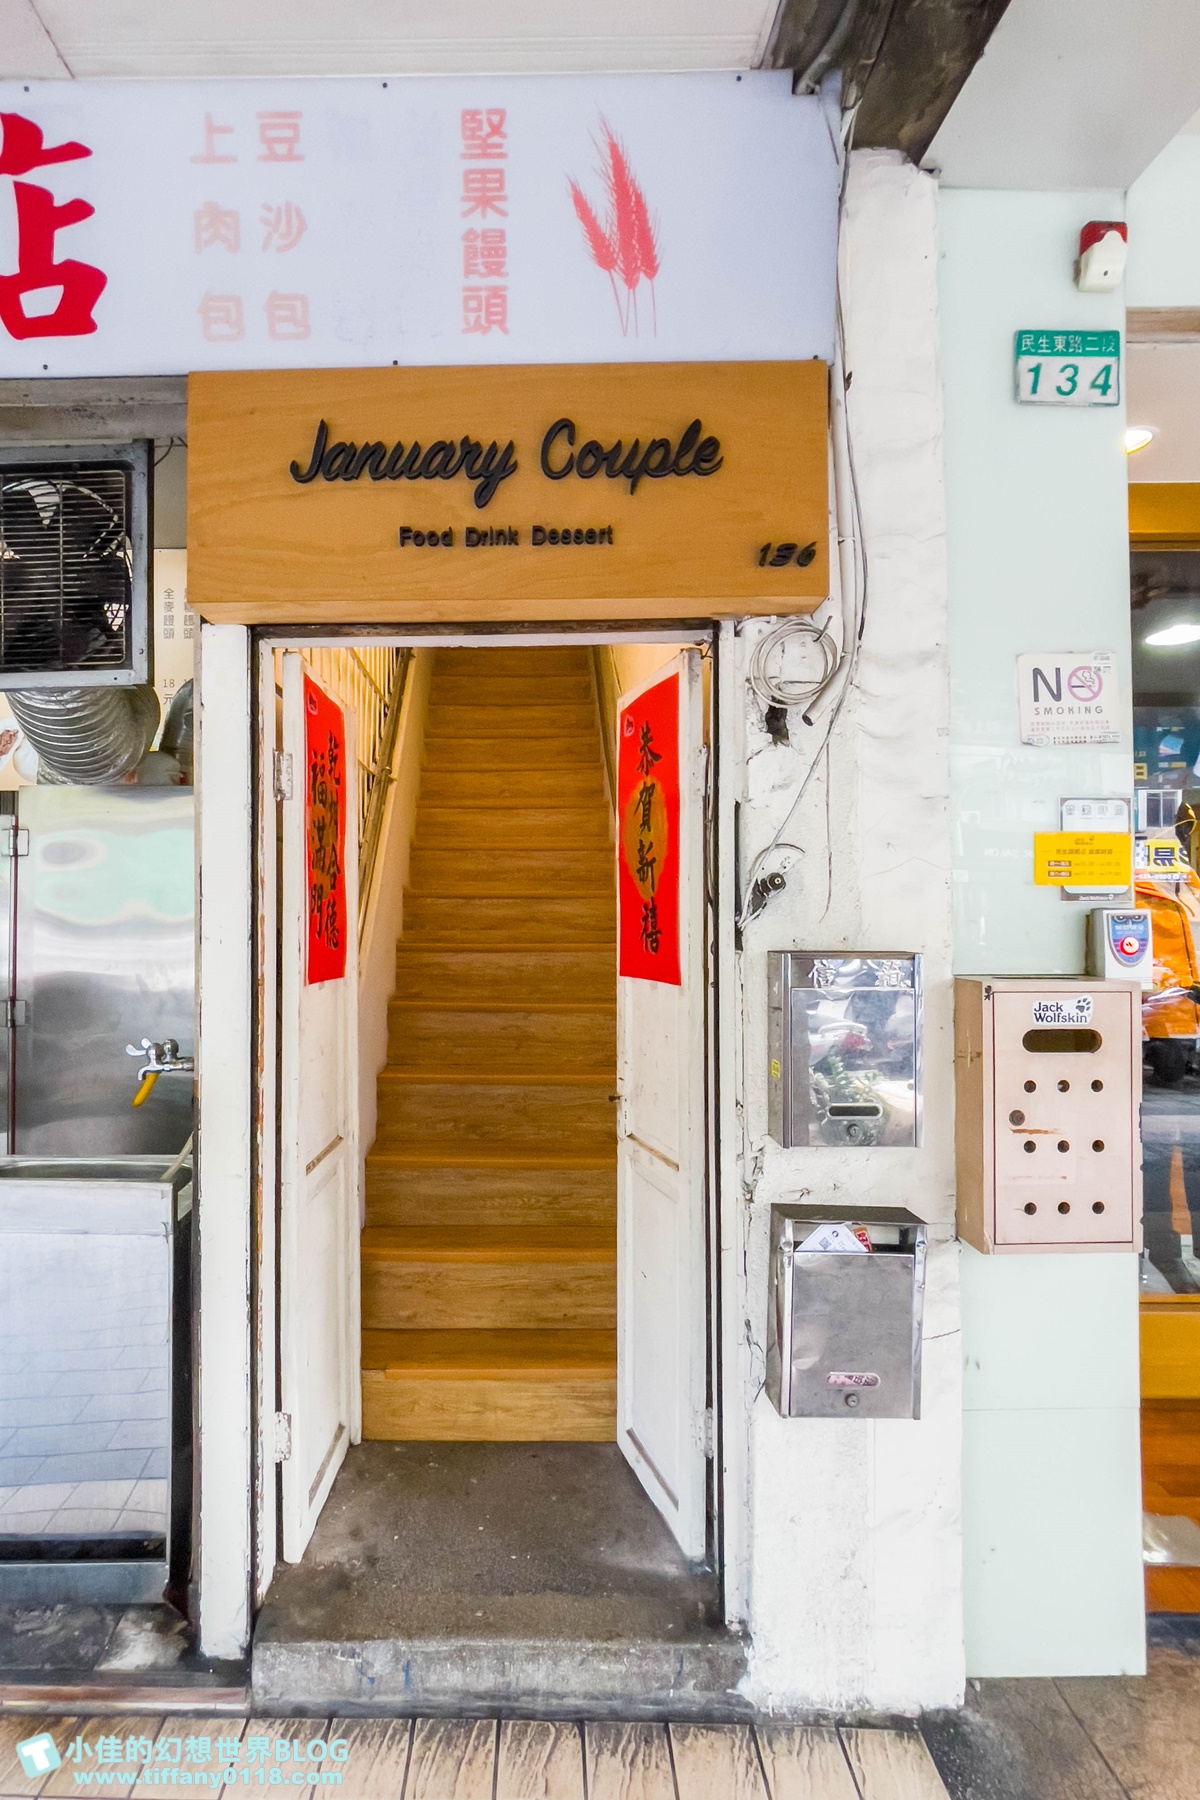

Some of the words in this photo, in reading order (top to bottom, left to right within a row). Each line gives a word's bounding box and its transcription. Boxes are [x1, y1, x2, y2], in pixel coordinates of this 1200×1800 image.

[256, 111, 311, 342] 豆沙包
[460, 108, 510, 336] 堅果饅頭
[1026, 362, 1114, 397] 134
[290, 418, 518, 509] January
[540, 418, 724, 495] Couple
[399, 526, 453, 547] Food
[465, 526, 519, 547] Drink
[531, 524, 614, 547] Dessert
[759, 541, 817, 568] 136
[163, 587, 175, 640] 全麥饅頭
[1034, 705, 1104, 716] SMOKING
[1033, 1001, 1064, 1013] Jack
[1033, 1012, 1088, 1024] Wolfskin
